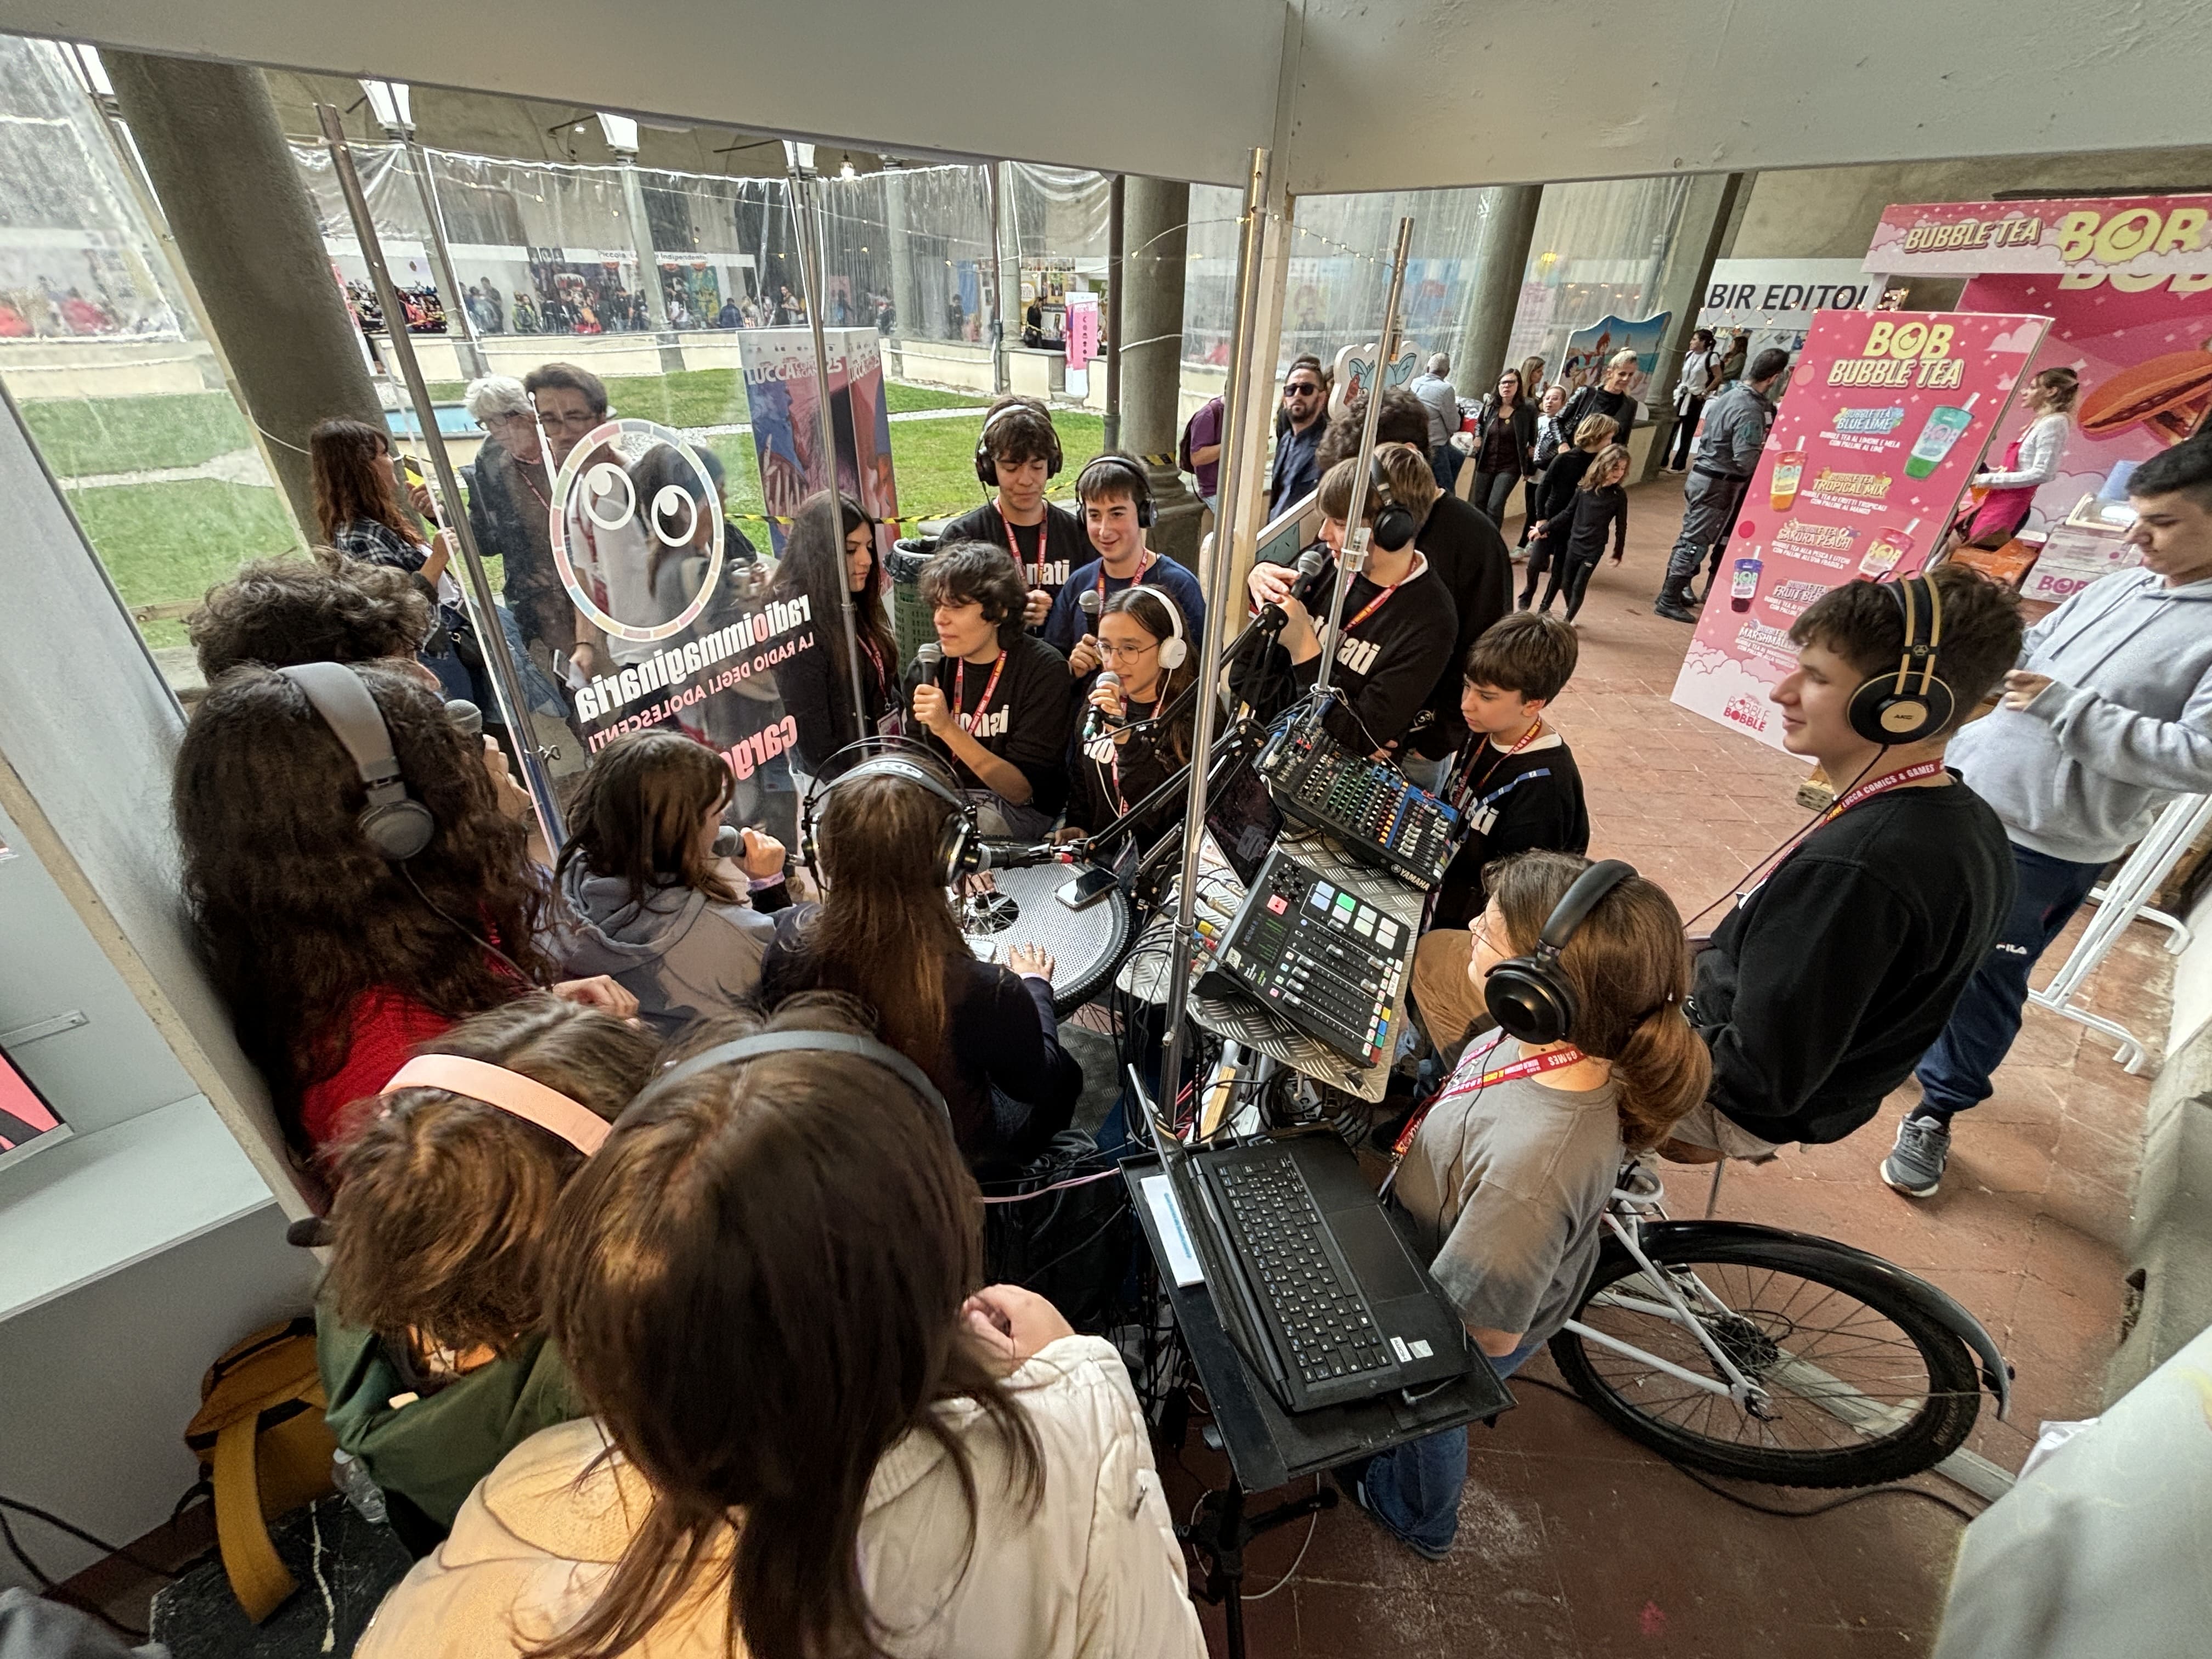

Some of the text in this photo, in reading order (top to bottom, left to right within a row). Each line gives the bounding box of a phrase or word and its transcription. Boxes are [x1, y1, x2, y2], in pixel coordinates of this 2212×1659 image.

[1903, 224, 1991, 254] BUBBLE
[1993, 217, 2043, 246] TEA
[1707, 284, 1756, 309] BIR
[1862, 321, 1954, 359] BOB
[746, 362, 797, 385] LUCCA
[1827, 359, 1965, 390] BUBBLE TEA
[1837, 417, 1893, 431] BLUE LIME
[1813, 479, 1888, 497] TROPICAL MIX
[1776, 528, 1853, 550] SAKURA PEACH
[1773, 586, 1800, 600] FRUIT
[1841, 763, 1936, 808] LUCCA COMICS & GAMES
[1400, 868, 1430, 891] YAMAHA
[1996, 943, 2027, 955] FILA
[1547, 1049, 1578, 1066] GAMES
